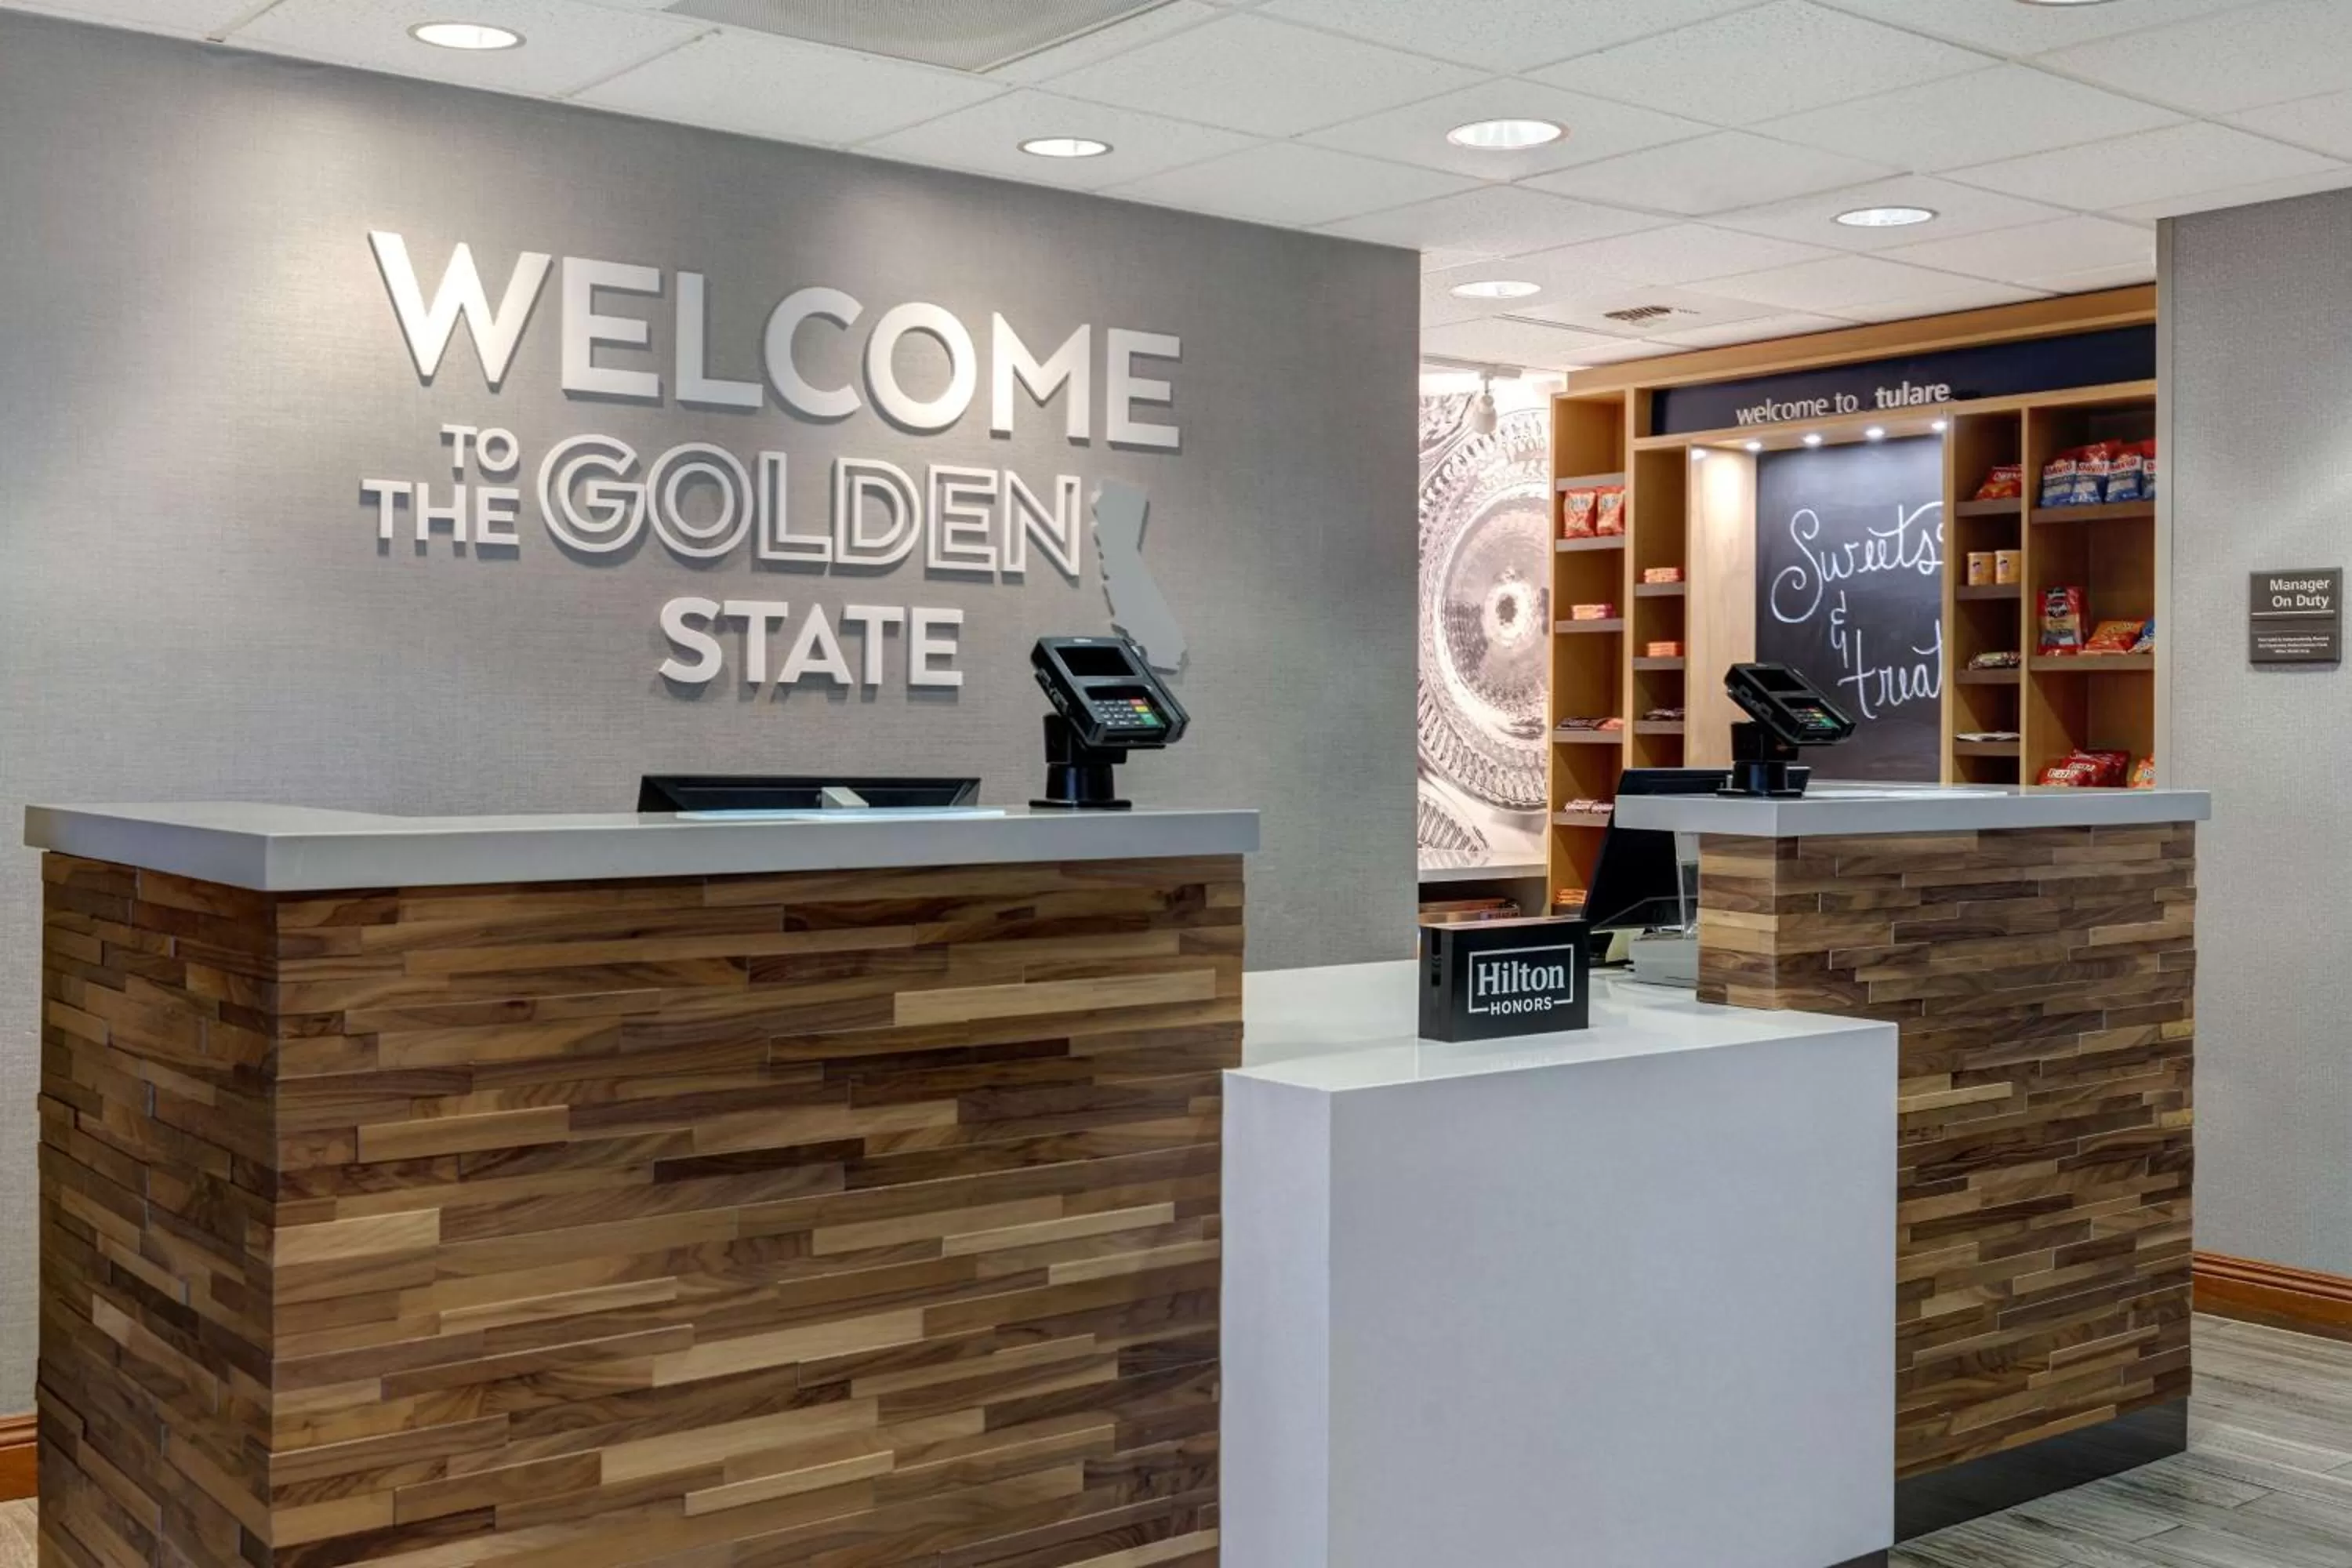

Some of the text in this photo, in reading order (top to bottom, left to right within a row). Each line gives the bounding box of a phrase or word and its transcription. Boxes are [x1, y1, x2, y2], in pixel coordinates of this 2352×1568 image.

[368, 230, 1182, 448] WELCOME
[1736, 380, 1951, 426] welcome to tulare
[441, 423, 519, 472] TO
[361, 434, 1081, 576] THE GOLDEN
[1771, 502, 1944, 622] Sweets
[2270, 579, 2330, 593] Manager
[2272, 593, 2329, 608] On Duty
[659, 597, 964, 686] STATE
[1477, 960, 1565, 996] Hilton
[1490, 996, 1552, 1015] HONORS
